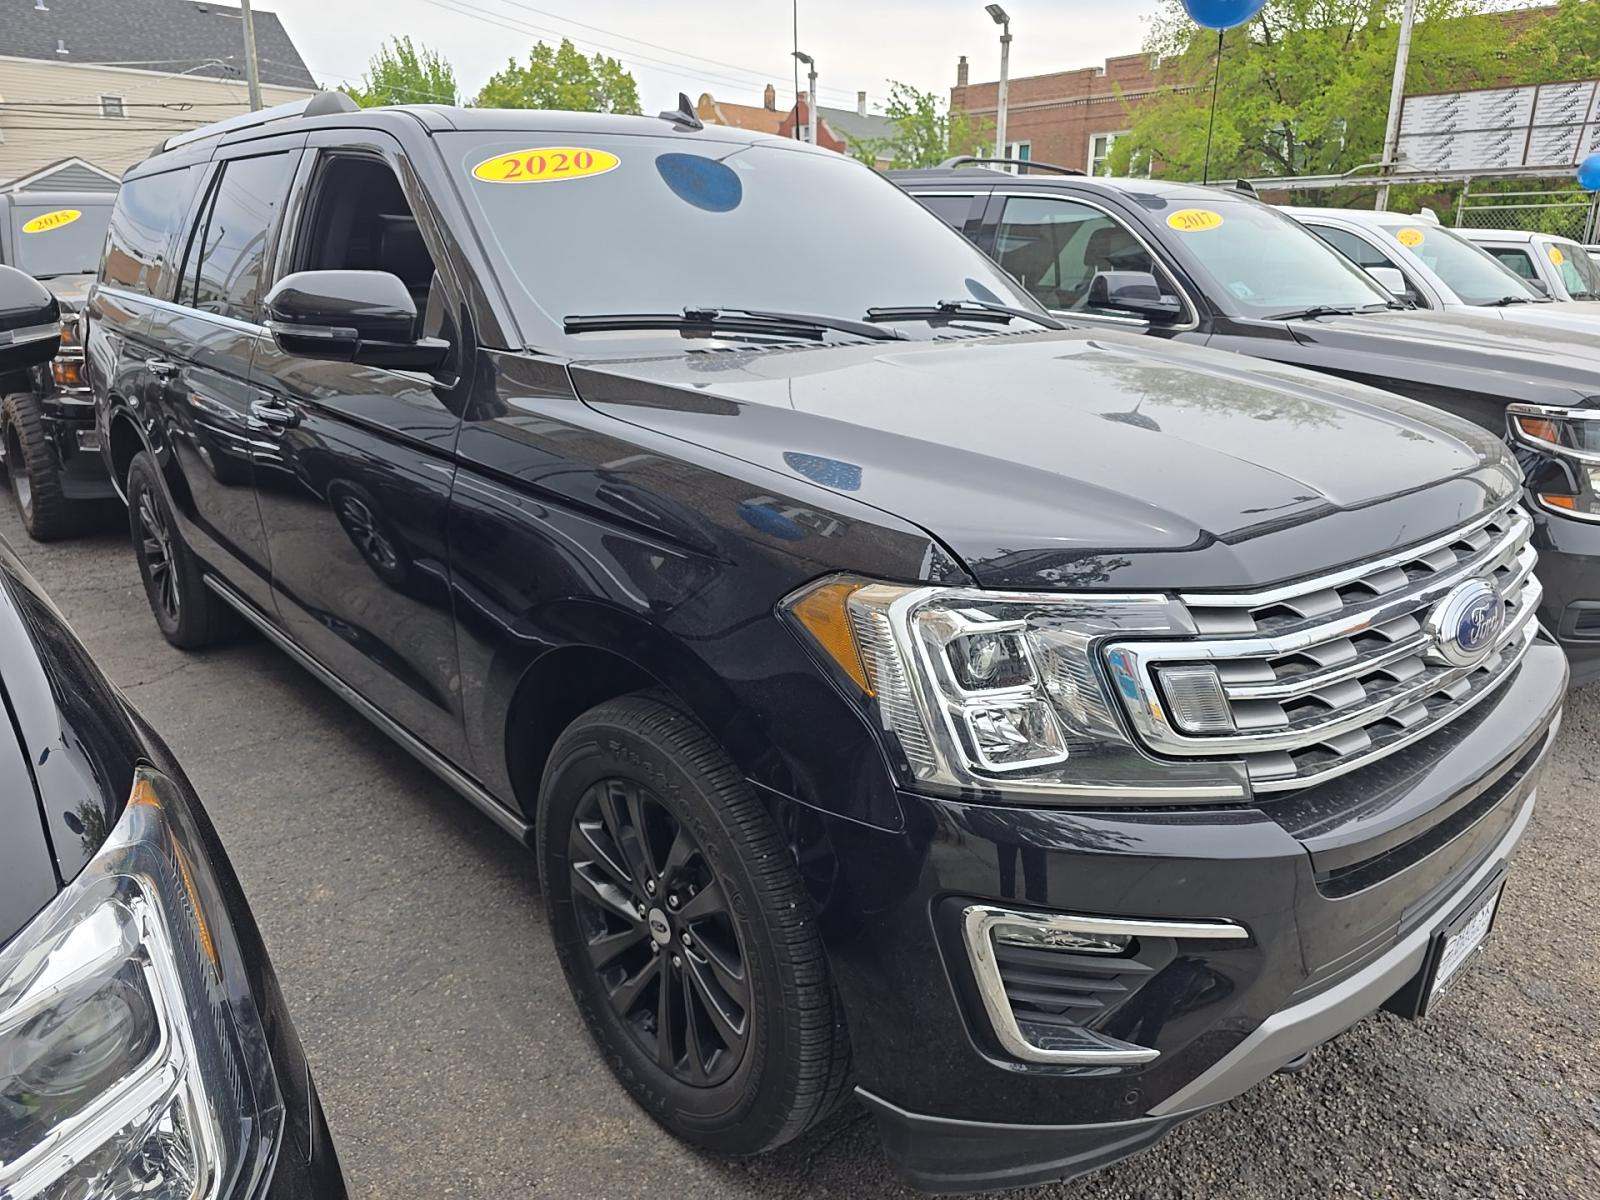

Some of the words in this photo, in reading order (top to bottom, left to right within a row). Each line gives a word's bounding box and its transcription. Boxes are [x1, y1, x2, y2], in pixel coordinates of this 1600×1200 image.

[502, 151, 593, 179] 2020
[1178, 212, 1213, 229] 2017
[1470, 602, 1499, 644] Ford
